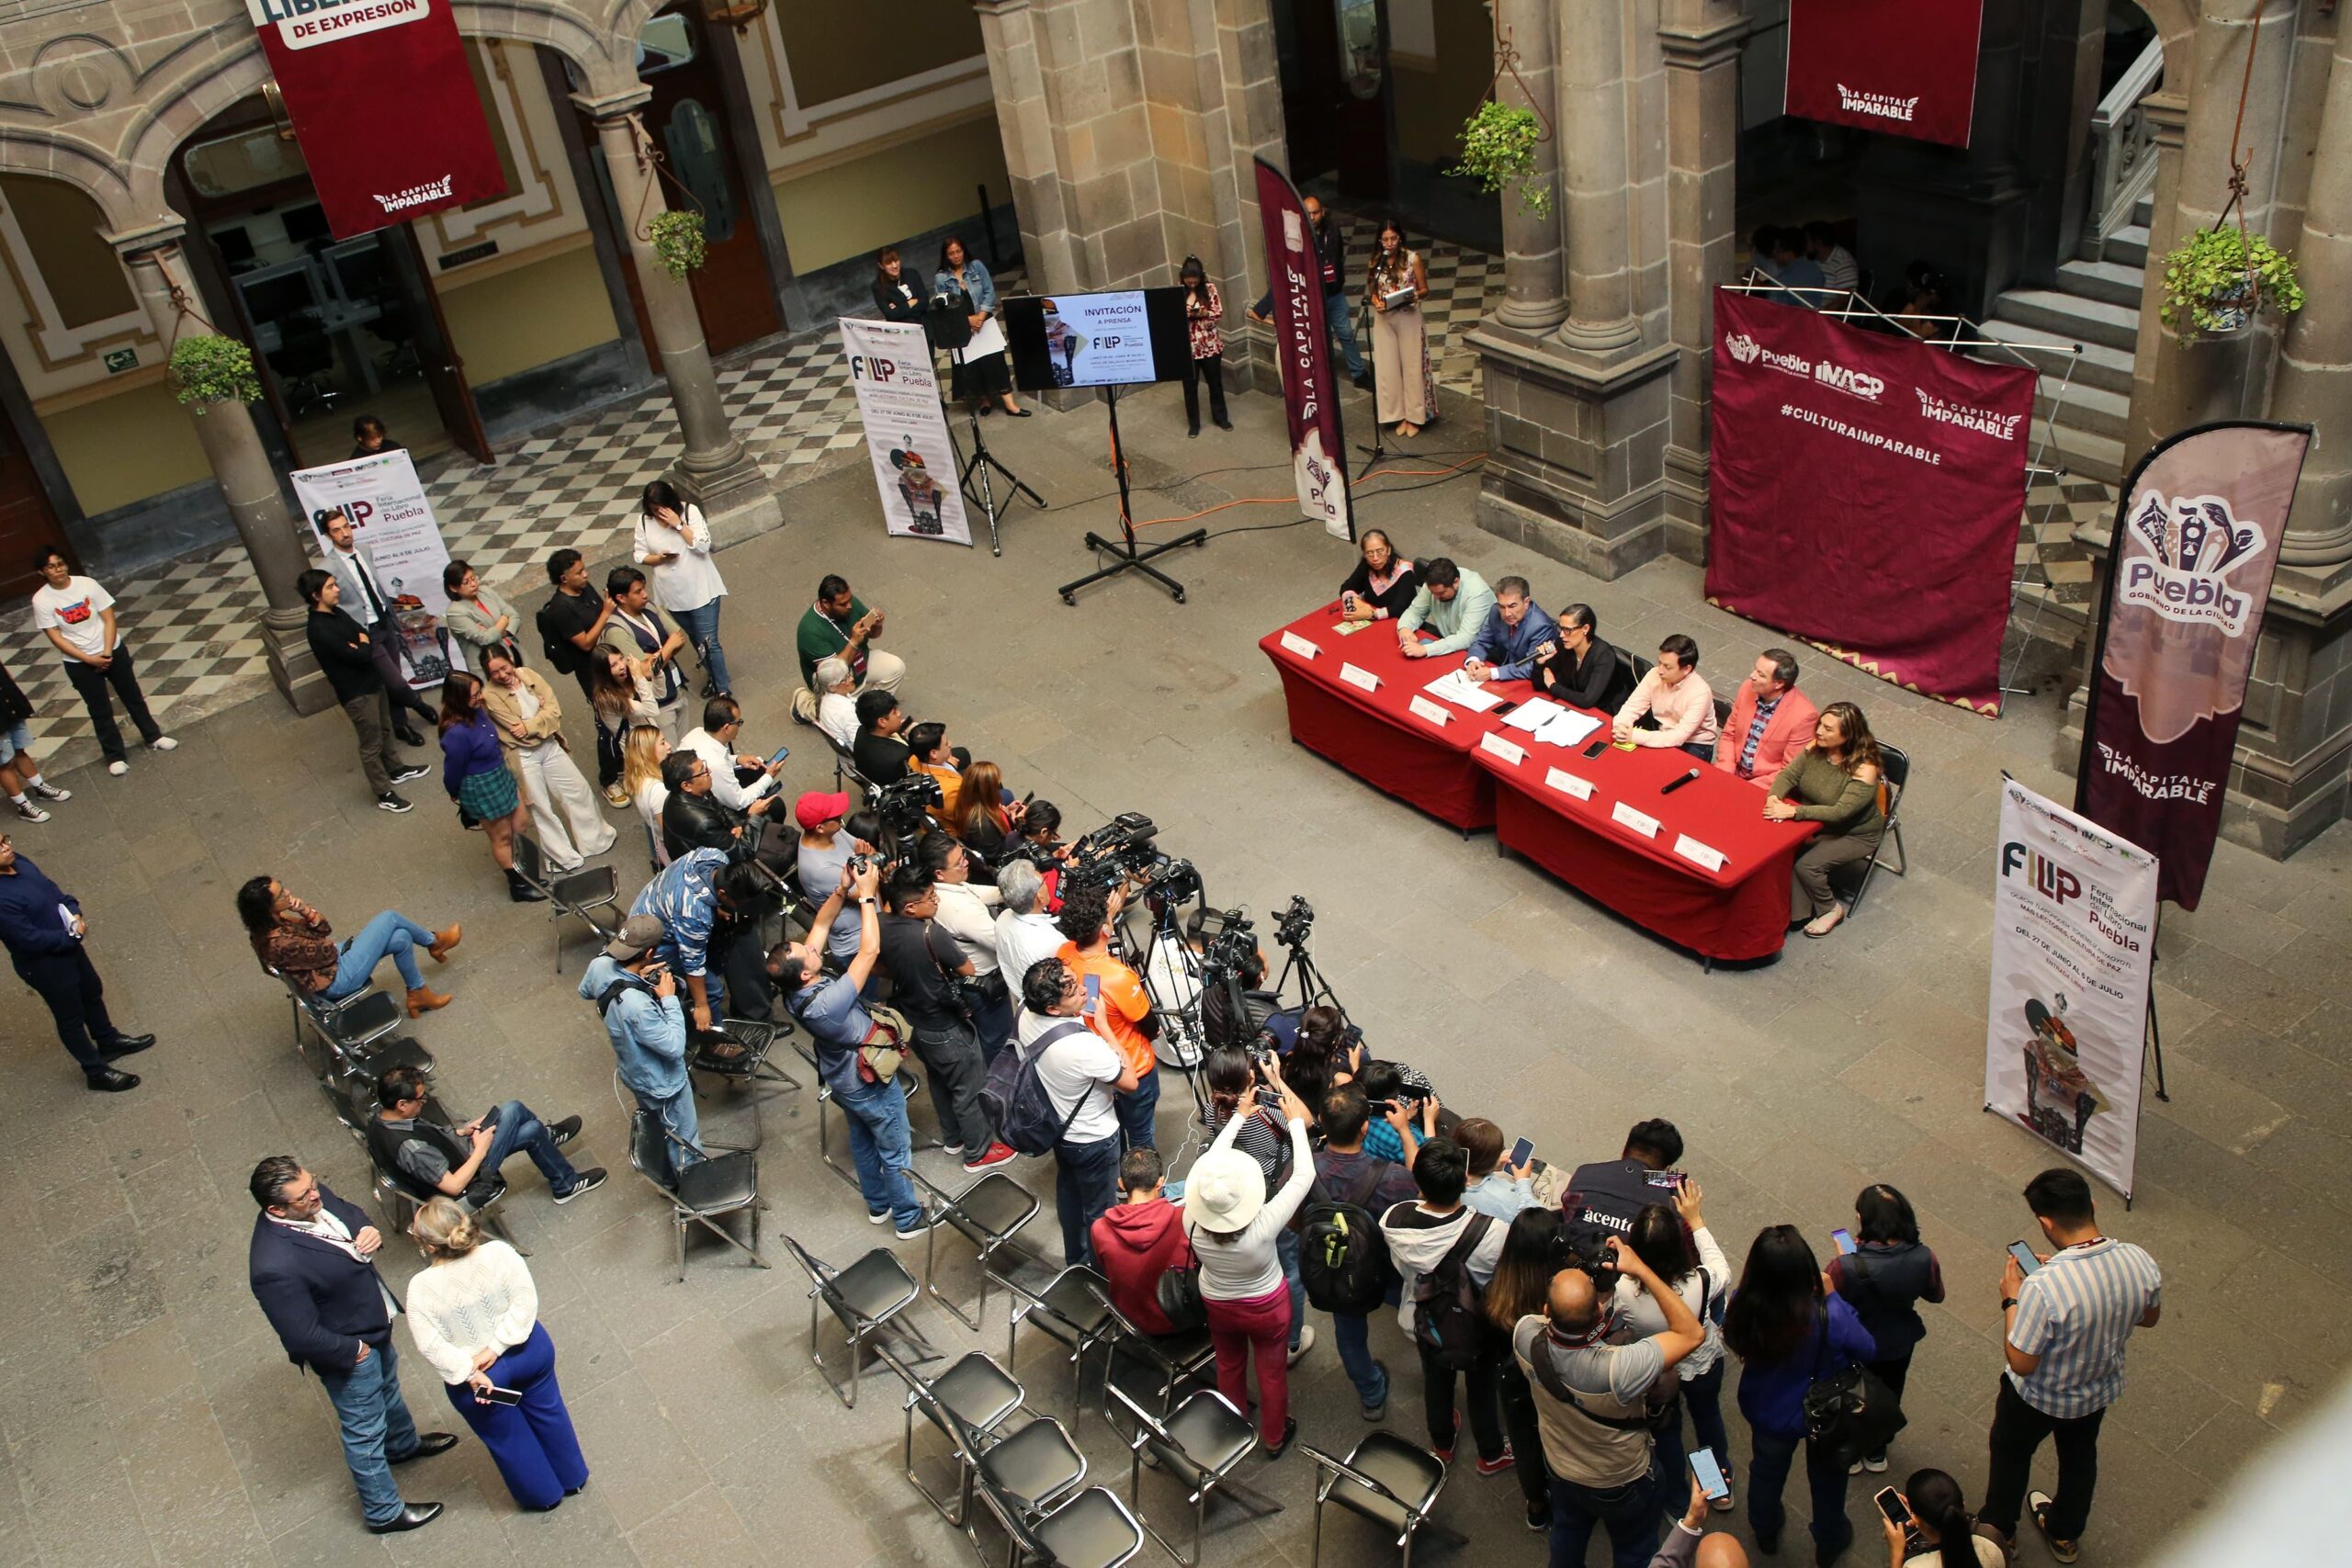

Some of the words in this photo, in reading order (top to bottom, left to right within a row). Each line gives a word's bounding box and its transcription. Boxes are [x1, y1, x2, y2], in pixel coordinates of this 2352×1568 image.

[292, 22, 318, 38] DE
[1842, 97, 1913, 121] IMPARABLE
[1848, 90, 1860, 98] LA
[1864, 93, 1906, 107] CAPITAL
[383, 186, 452, 213] IMPARABLE
[384, 193, 398, 201] LA
[401, 181, 443, 197] CAPITAL
[1084, 304, 1142, 316] INVITACIÓN
[1290, 286, 1311, 368] CAPITAL
[1761, 349, 1811, 374] Puebla
[902, 377, 933, 387] Puebla
[1303, 378, 1317, 399] LA
[1922, 404, 2014, 440] IMPARABLE
[1929, 396, 1944, 408] LA
[1951, 403, 2008, 424] CAPITAL
[1781, 403, 1941, 466] #CULTURAIMPARABLE
[376, 495, 393, 503] Feria
[378, 493, 423, 508] Internacional
[391, 502, 410, 513] Libro
[383, 506, 424, 523] Puebla
[2130, 563, 2243, 619] Puebla
[2129, 592, 2171, 612] GOBIERNO
[2205, 610, 2235, 630] CIUDAD
[2115, 751, 2132, 765] LA
[2134, 764, 2201, 787] CAPITAL
[2105, 760, 2209, 806] IMPARABLE
[2090, 884, 2113, 902] Feria
[2090, 894, 2147, 932] Internacional
[2090, 902, 2102, 914] del
[2103, 908, 2123, 930] Libro
[2089, 910, 2140, 953] Puebla
[2016, 926, 2031, 939] DEL
[2031, 934, 2041, 944] 27
[2041, 941, 2051, 952] DE
[2052, 949, 2072, 967] JUNIO
[2072, 964, 2080, 975] AL
[2086, 976, 2098, 987] DE
[2098, 983, 2124, 999] JULIO
[2071, 935, 2096, 958] CULTURA
[2097, 954, 2105, 965] DE
[2106, 962, 2122, 974] PAZ
[2045, 957, 2070, 979] ENTRADA
